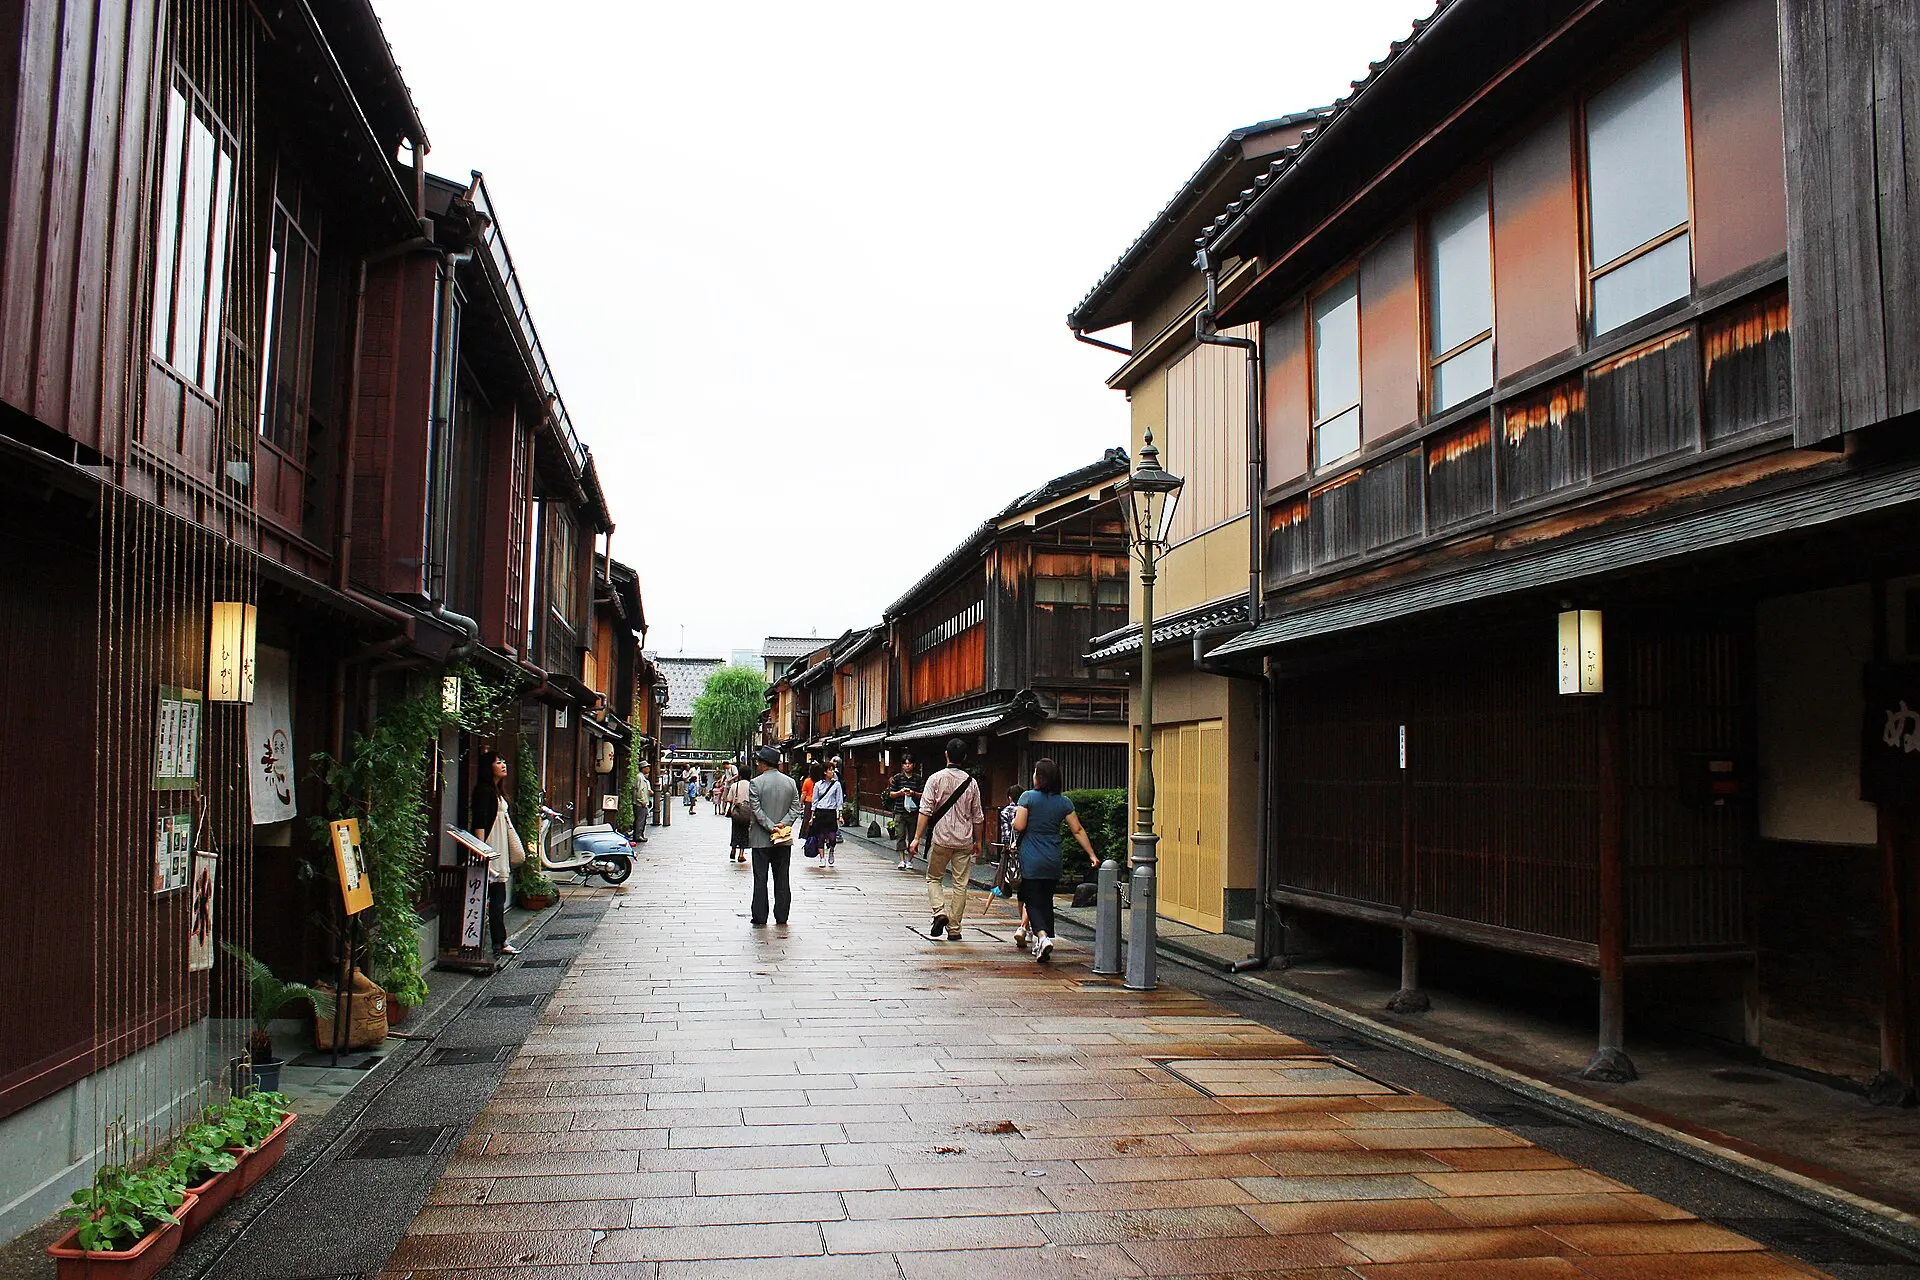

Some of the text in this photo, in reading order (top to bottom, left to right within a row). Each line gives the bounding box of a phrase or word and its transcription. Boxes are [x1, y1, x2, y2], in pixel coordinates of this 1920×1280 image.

[220, 645, 231, 694] ひがし
[1587, 650, 1596, 686] ひがし
